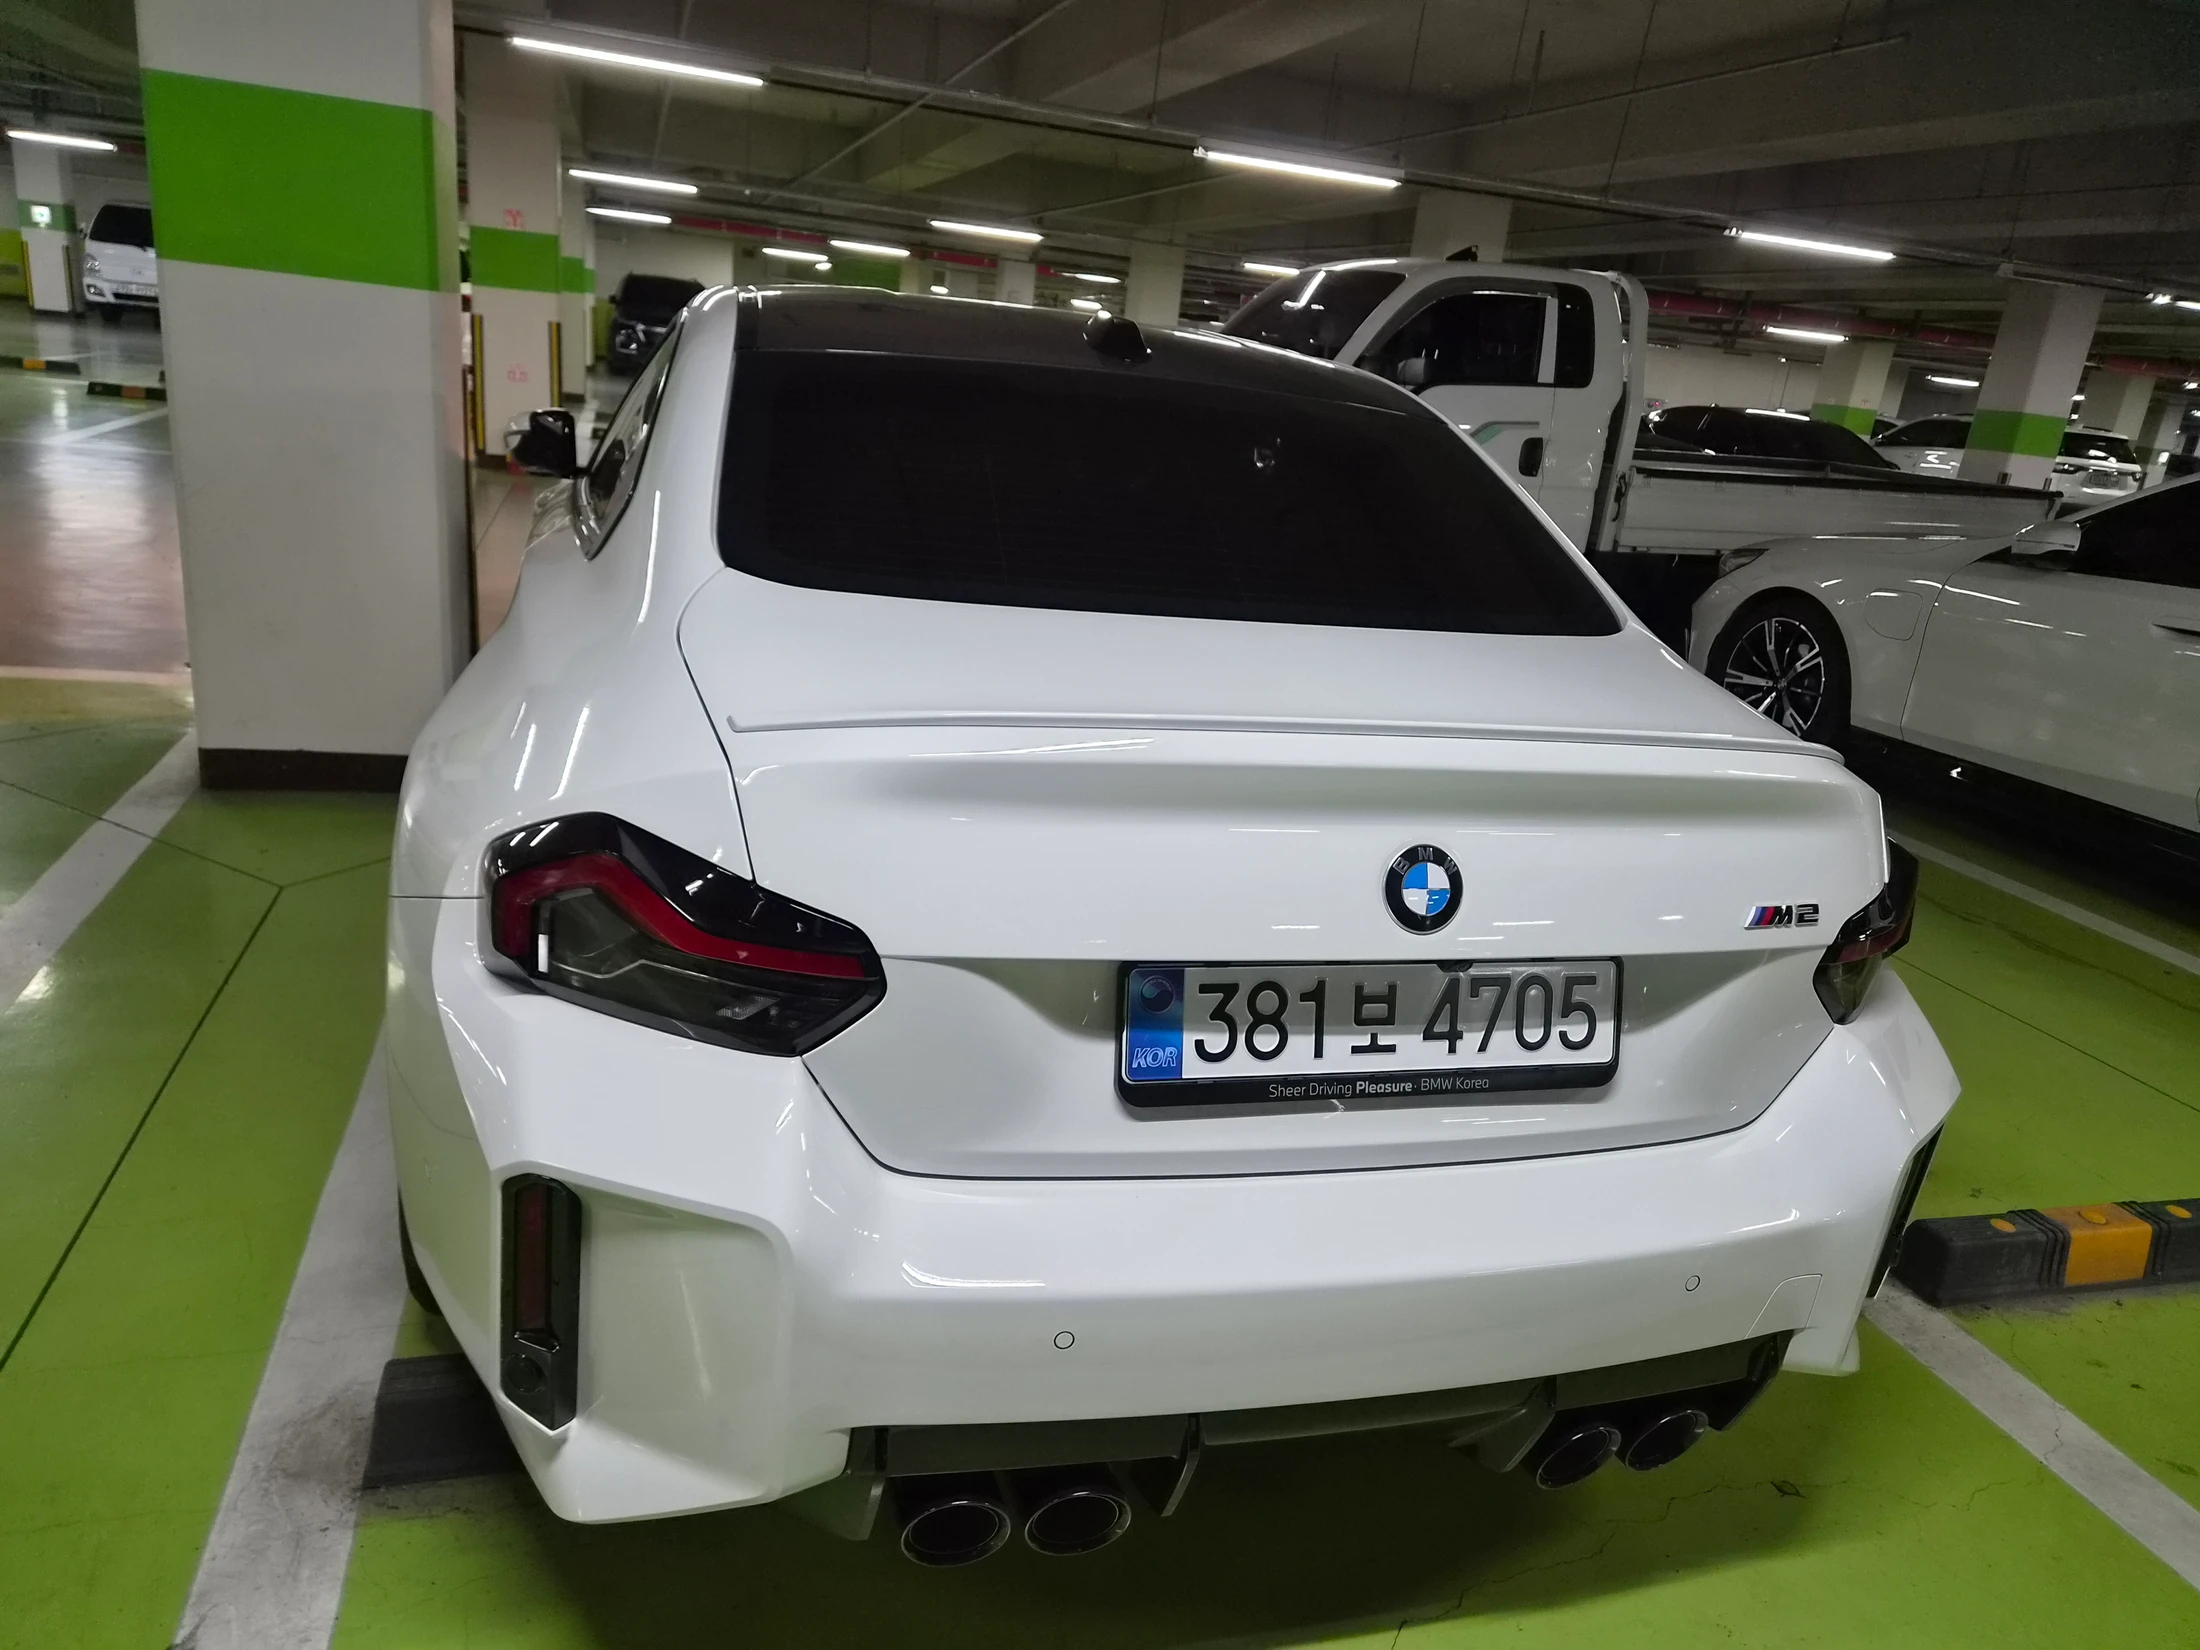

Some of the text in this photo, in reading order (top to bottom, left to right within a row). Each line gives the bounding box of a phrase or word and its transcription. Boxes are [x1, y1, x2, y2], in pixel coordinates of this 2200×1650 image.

[1393, 847, 1458, 875] BMW
[1744, 903, 1819, 929] M2
[1422, 974, 1598, 1054] 4705
[1132, 1047, 1178, 1068] KOR
[1269, 1084, 1306, 1097] Sheer
[1309, 1082, 1352, 1097] Driving
[1421, 1077, 1453, 1091] BMW
[1456, 1077, 1489, 1090] Korea
